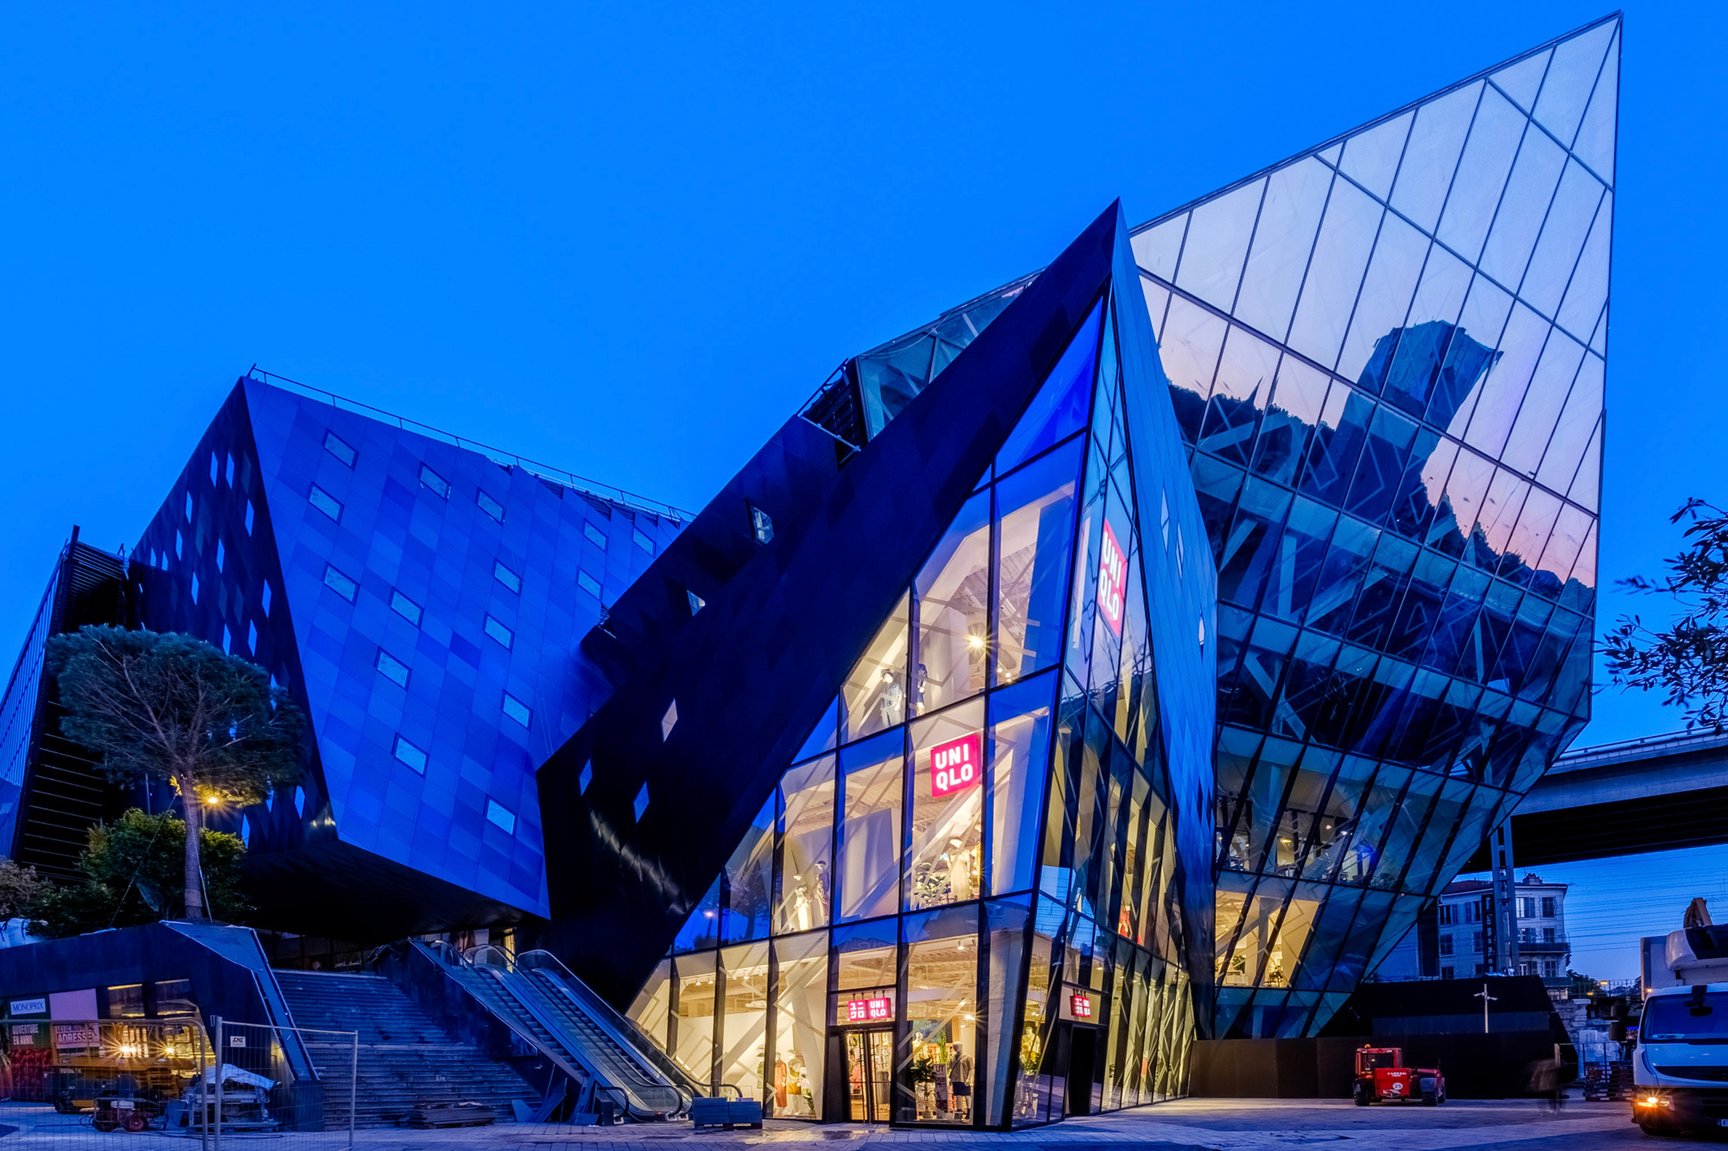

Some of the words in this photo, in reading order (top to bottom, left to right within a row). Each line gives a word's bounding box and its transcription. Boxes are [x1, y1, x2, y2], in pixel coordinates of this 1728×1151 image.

[1103, 531, 1121, 588] UNI
[1100, 568, 1119, 620] QLO
[935, 743, 969, 769] UNI
[936, 763, 973, 791] QLO
[12, 1002, 44, 1012] MONOPRIX
[850, 1001, 864, 1010] ユニ
[870, 999, 885, 1008] UNI
[870, 1008, 886, 1018] QLO
[12, 1024, 39, 1034] OUVERTURE
[935, 1065, 944, 1073] UT
